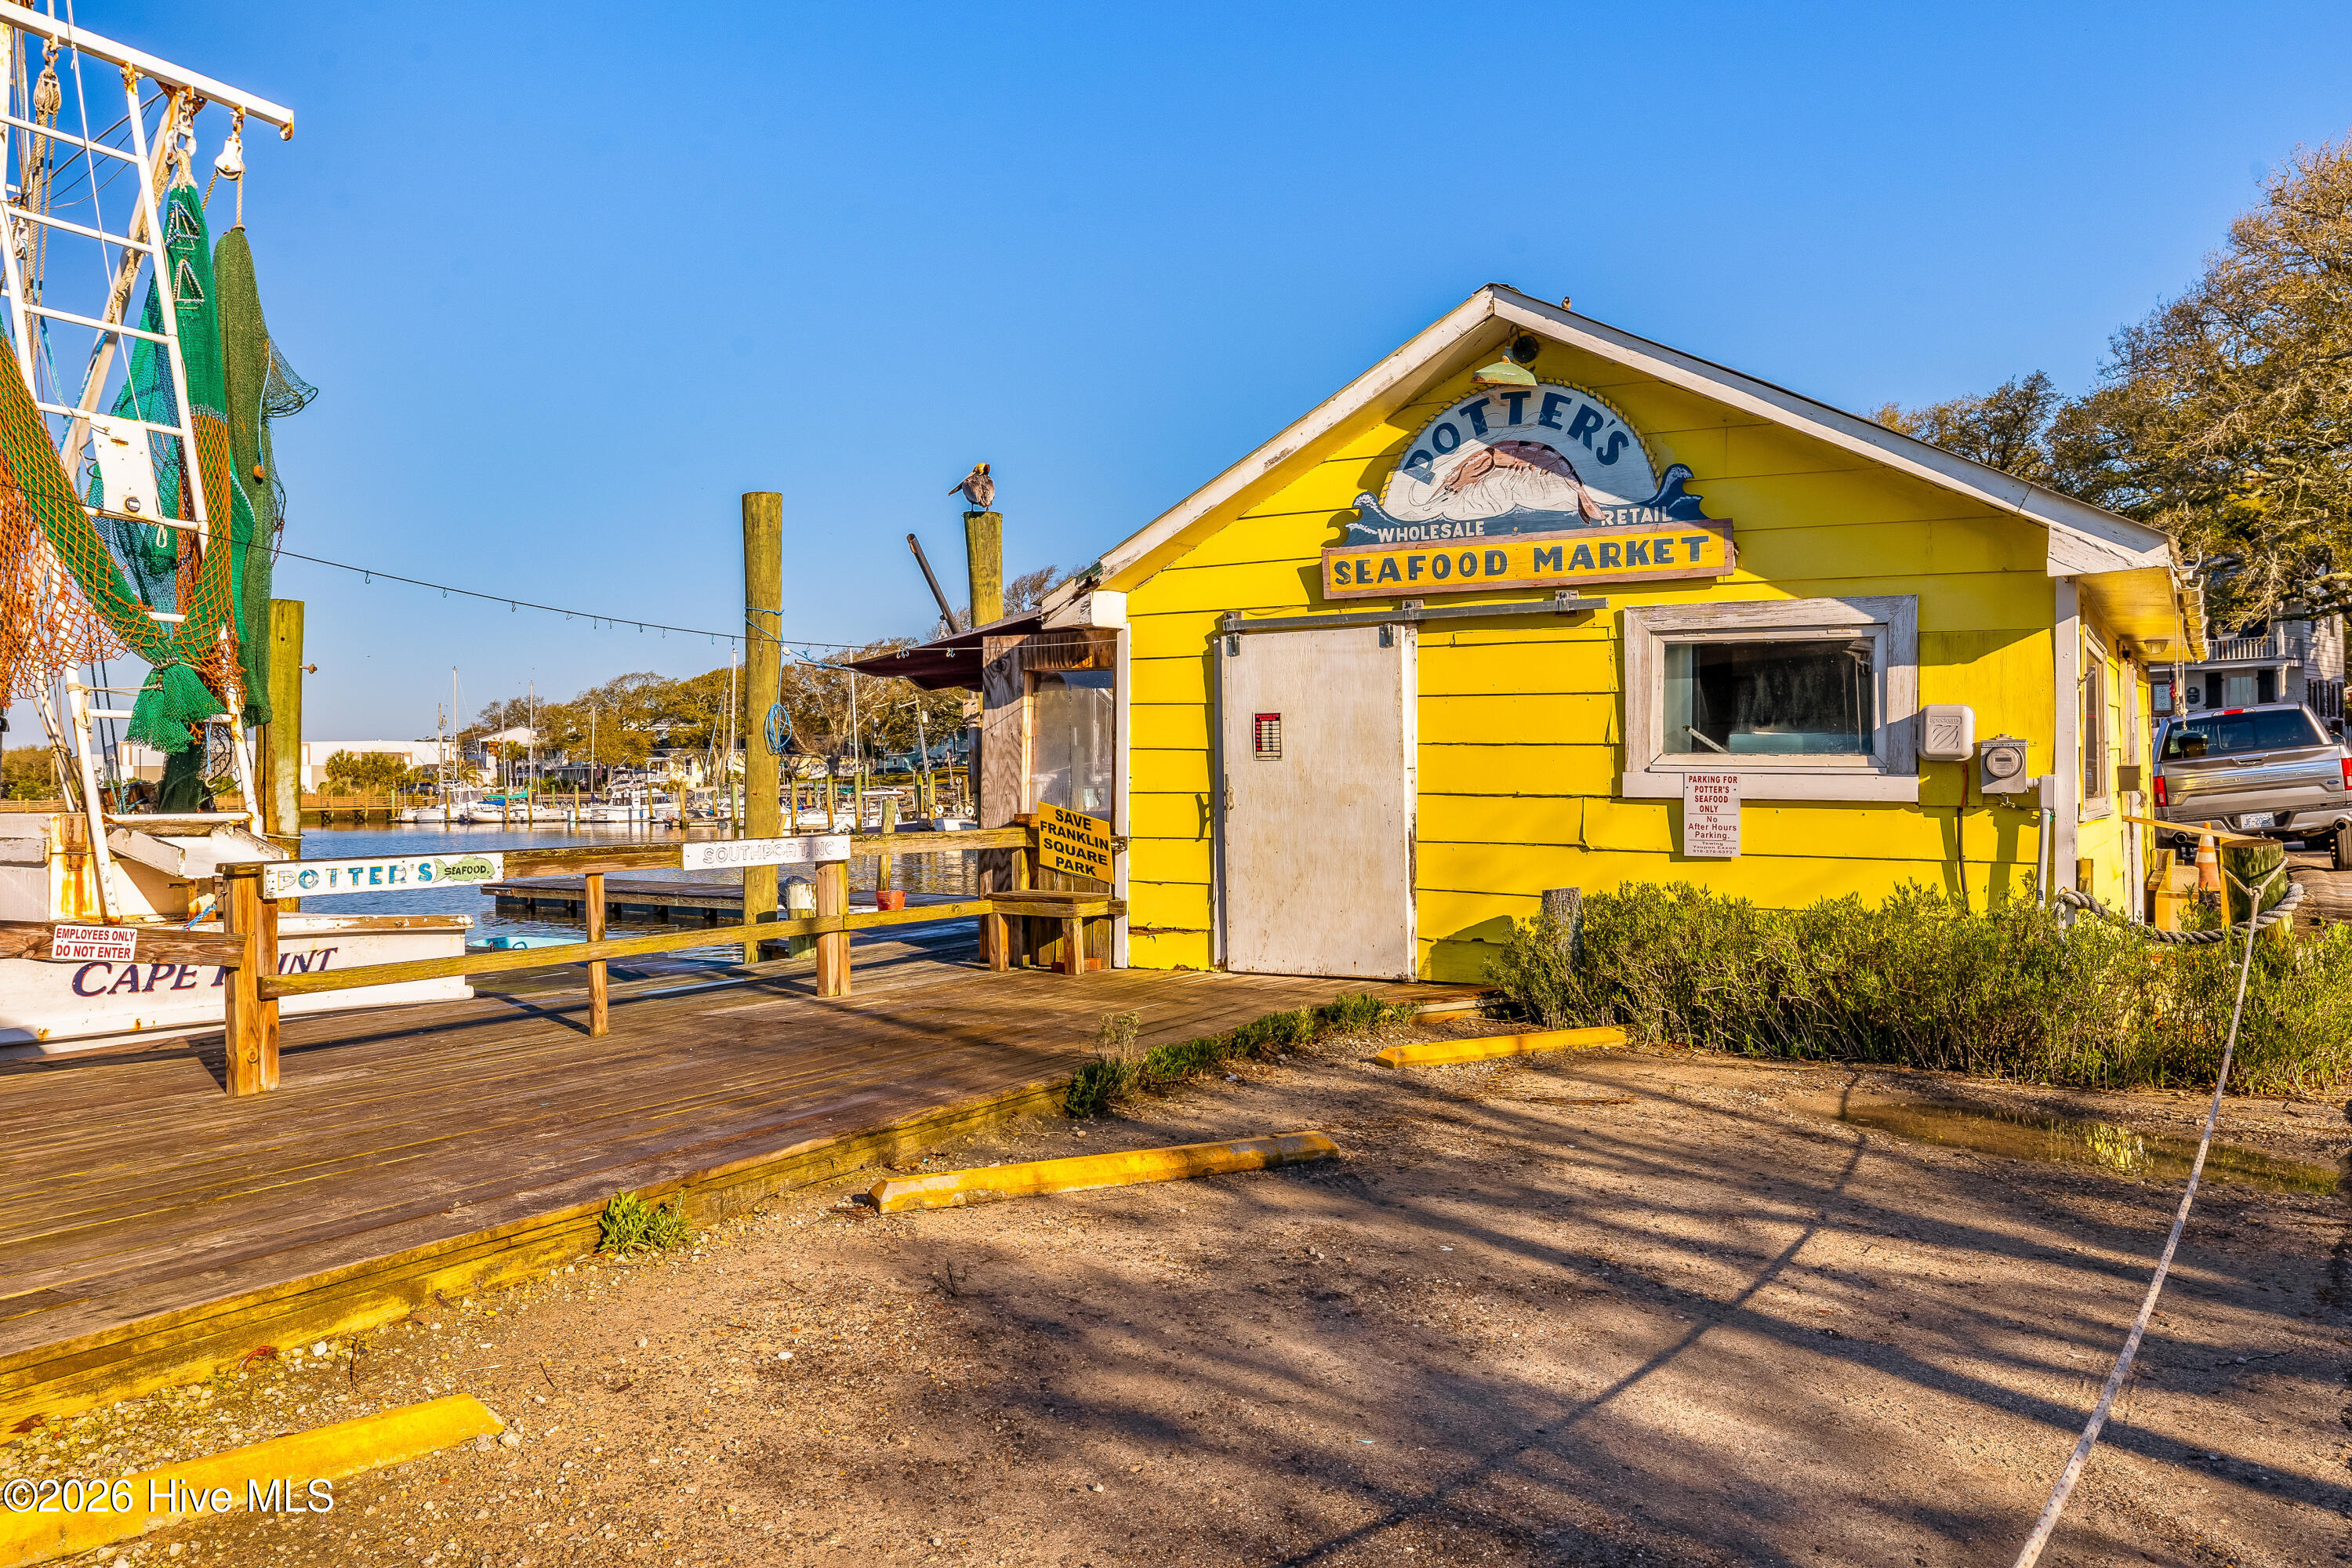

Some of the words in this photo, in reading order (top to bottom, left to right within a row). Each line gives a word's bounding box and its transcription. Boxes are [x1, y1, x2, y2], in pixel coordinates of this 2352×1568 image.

[1403, 390, 1629, 485] POTTER'S
[1601, 506, 1673, 526] RETAIL
[1377, 520, 1486, 543] WHOLESALE
[1333, 550, 1510, 586] SEAFOOD
[1533, 535, 1711, 574] MARKET
[1694, 785, 1730, 793] POTTER'S
[1722, 775, 1738, 784] FOR
[1694, 795, 1729, 804] SEAFOOD
[1699, 804, 1719, 813] ONLY
[1054, 808, 1092, 832] SAVE
[1688, 822, 1709, 831] After
[1040, 820, 1109, 851] FRANKLIN
[1694, 831, 1730, 841] Parking.
[815, 840, 834, 855] NC
[1044, 837, 1108, 866] SQUARE
[1055, 855, 1097, 877] PARK
[278, 862, 433, 891] POTTER'S
[56, 927, 109, 941] EMPLOYEES
[111, 931, 136, 942] ONLY
[55, 945, 69, 957] DO
[73, 945, 95, 958] NOT
[97, 946, 131, 959] ENTER
[71, 962, 198, 997] CAPE
